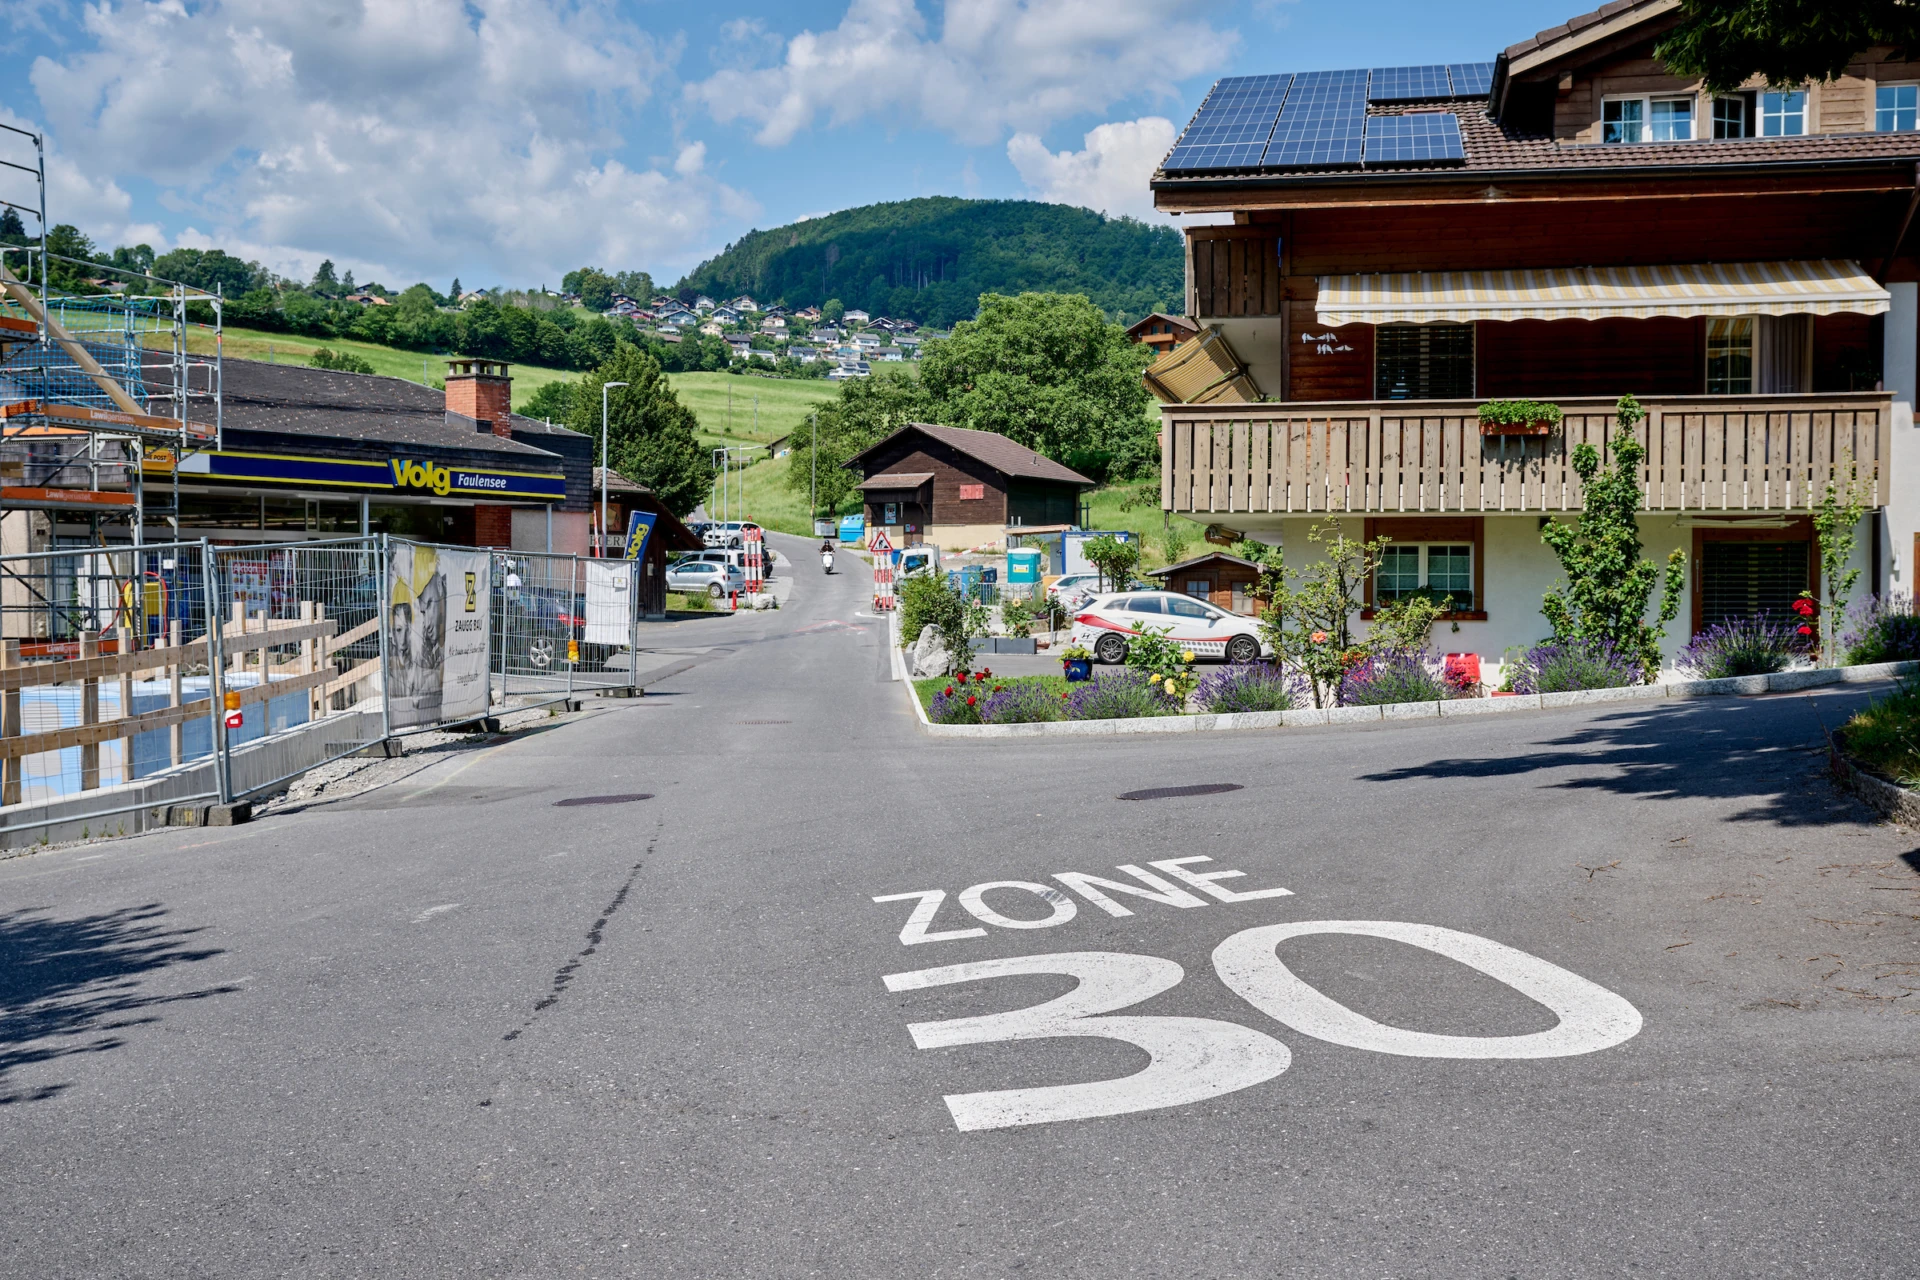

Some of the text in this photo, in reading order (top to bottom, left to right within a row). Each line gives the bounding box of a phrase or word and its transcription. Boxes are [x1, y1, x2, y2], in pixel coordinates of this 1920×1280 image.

[390, 458, 450, 496] Volg
[458, 473, 507, 488] Faulensee
[455, 619, 483, 632] ZAUGG BAU
[872, 855, 1296, 946] ZONE
[882, 919, 1643, 1132] 30
